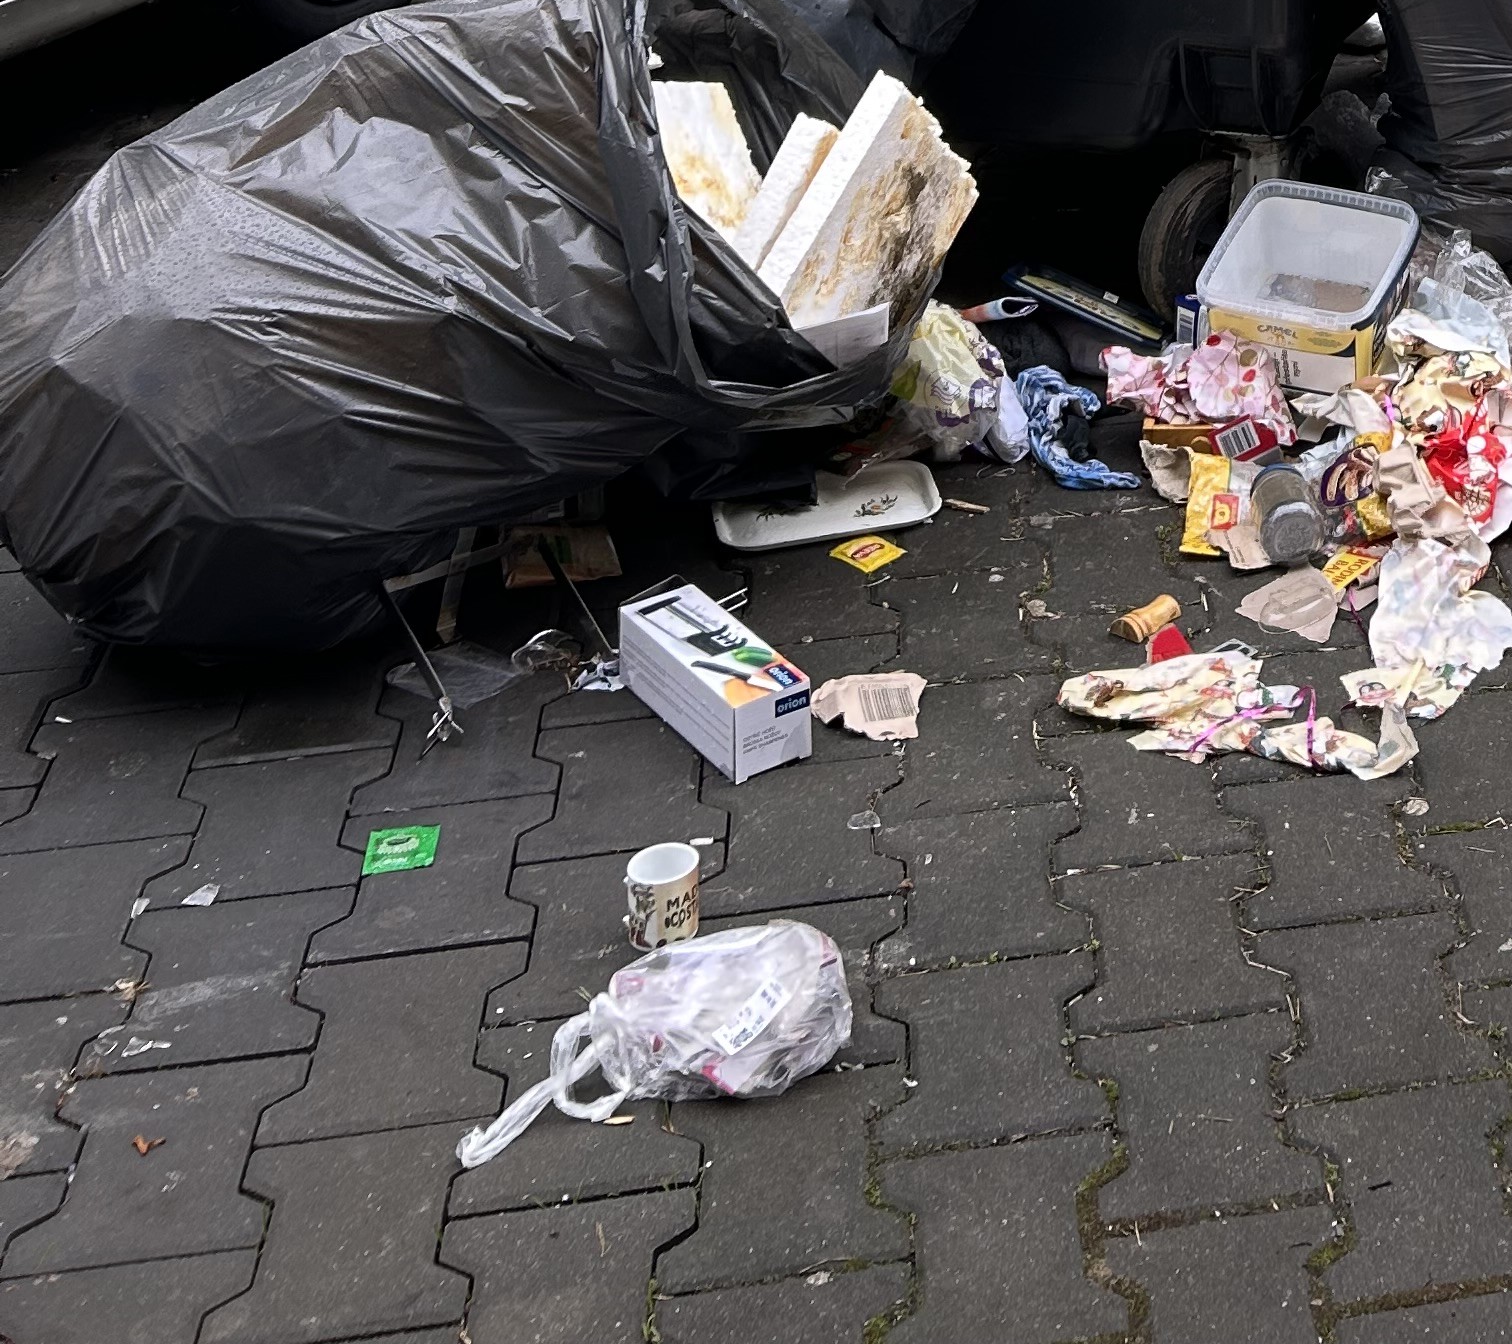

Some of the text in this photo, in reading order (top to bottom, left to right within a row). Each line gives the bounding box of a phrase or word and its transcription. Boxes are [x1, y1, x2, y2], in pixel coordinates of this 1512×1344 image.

[1256, 324, 1298, 340] CAMEL
[768, 666, 794, 685] orion
[776, 696, 807, 713] orion
